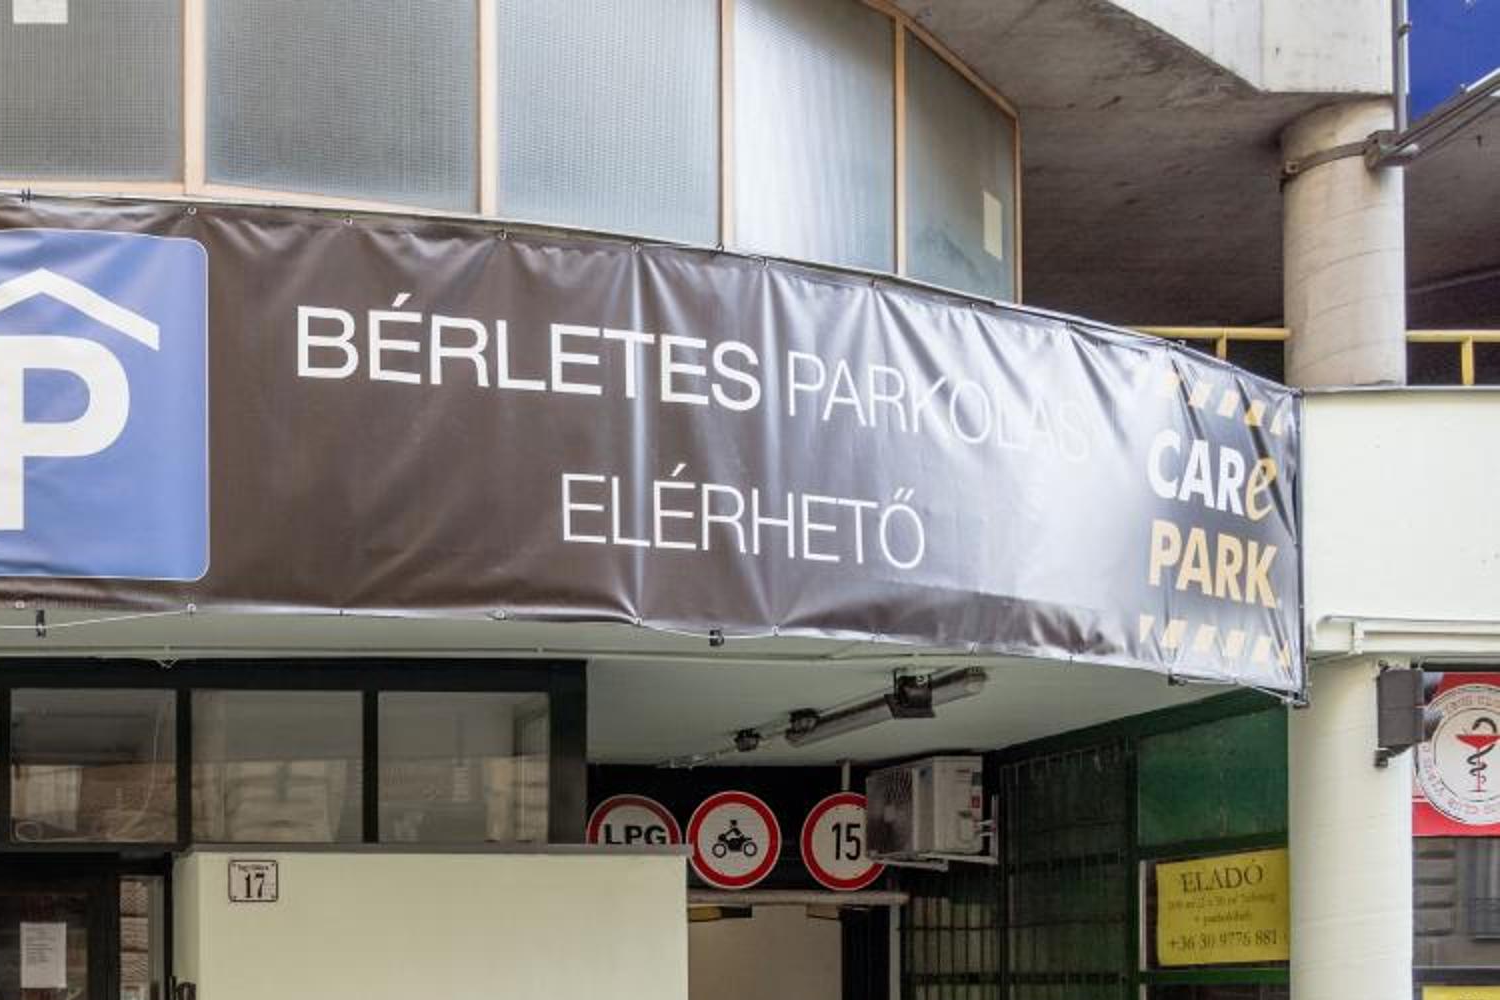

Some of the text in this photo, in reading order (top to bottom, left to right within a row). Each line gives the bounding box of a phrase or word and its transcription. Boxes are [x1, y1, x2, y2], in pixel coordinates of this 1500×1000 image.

[296, 293, 761, 412] BÉRLETES
[561, 463, 925, 570] ELÉRHETŐ
[1148, 519, 1278, 609] PARK
[604, 823, 667, 844] LPG
[831, 822, 862, 861] 15
[244, 873, 265, 898] 17
[1180, 859, 1264, 893] ELADÓ
